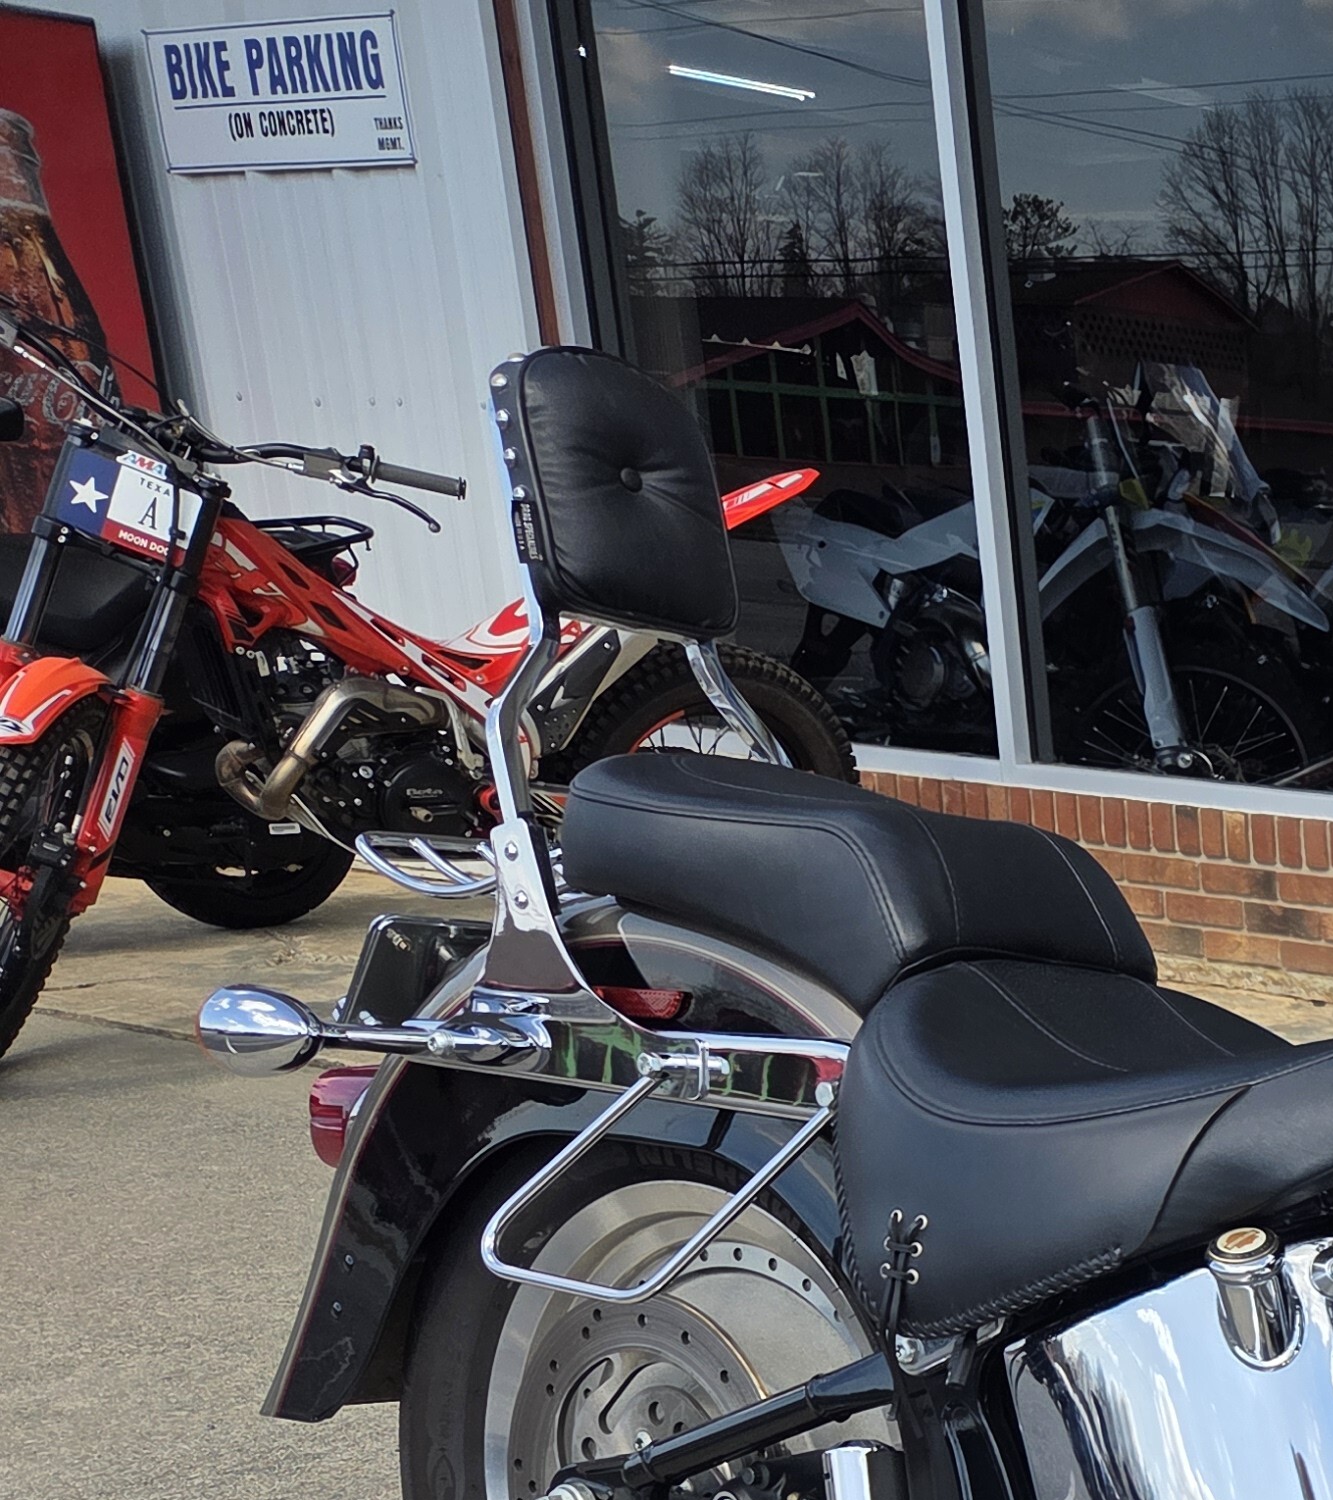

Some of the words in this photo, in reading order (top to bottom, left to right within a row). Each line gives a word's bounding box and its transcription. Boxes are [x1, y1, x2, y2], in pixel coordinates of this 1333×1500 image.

[164, 41, 236, 100] BIKE
[244, 29, 385, 96] PARKING
[228, 112, 254, 141] (ON
[258, 107, 336, 138] CONCRETE)
[373, 116, 404, 131] THANKS
[377, 137, 406, 151] MGMT.
[124, 453, 164, 477] AMA
[139, 477, 172, 497] TEXA
[137, 496, 158, 531] A
[118, 529, 148, 547] MOON
